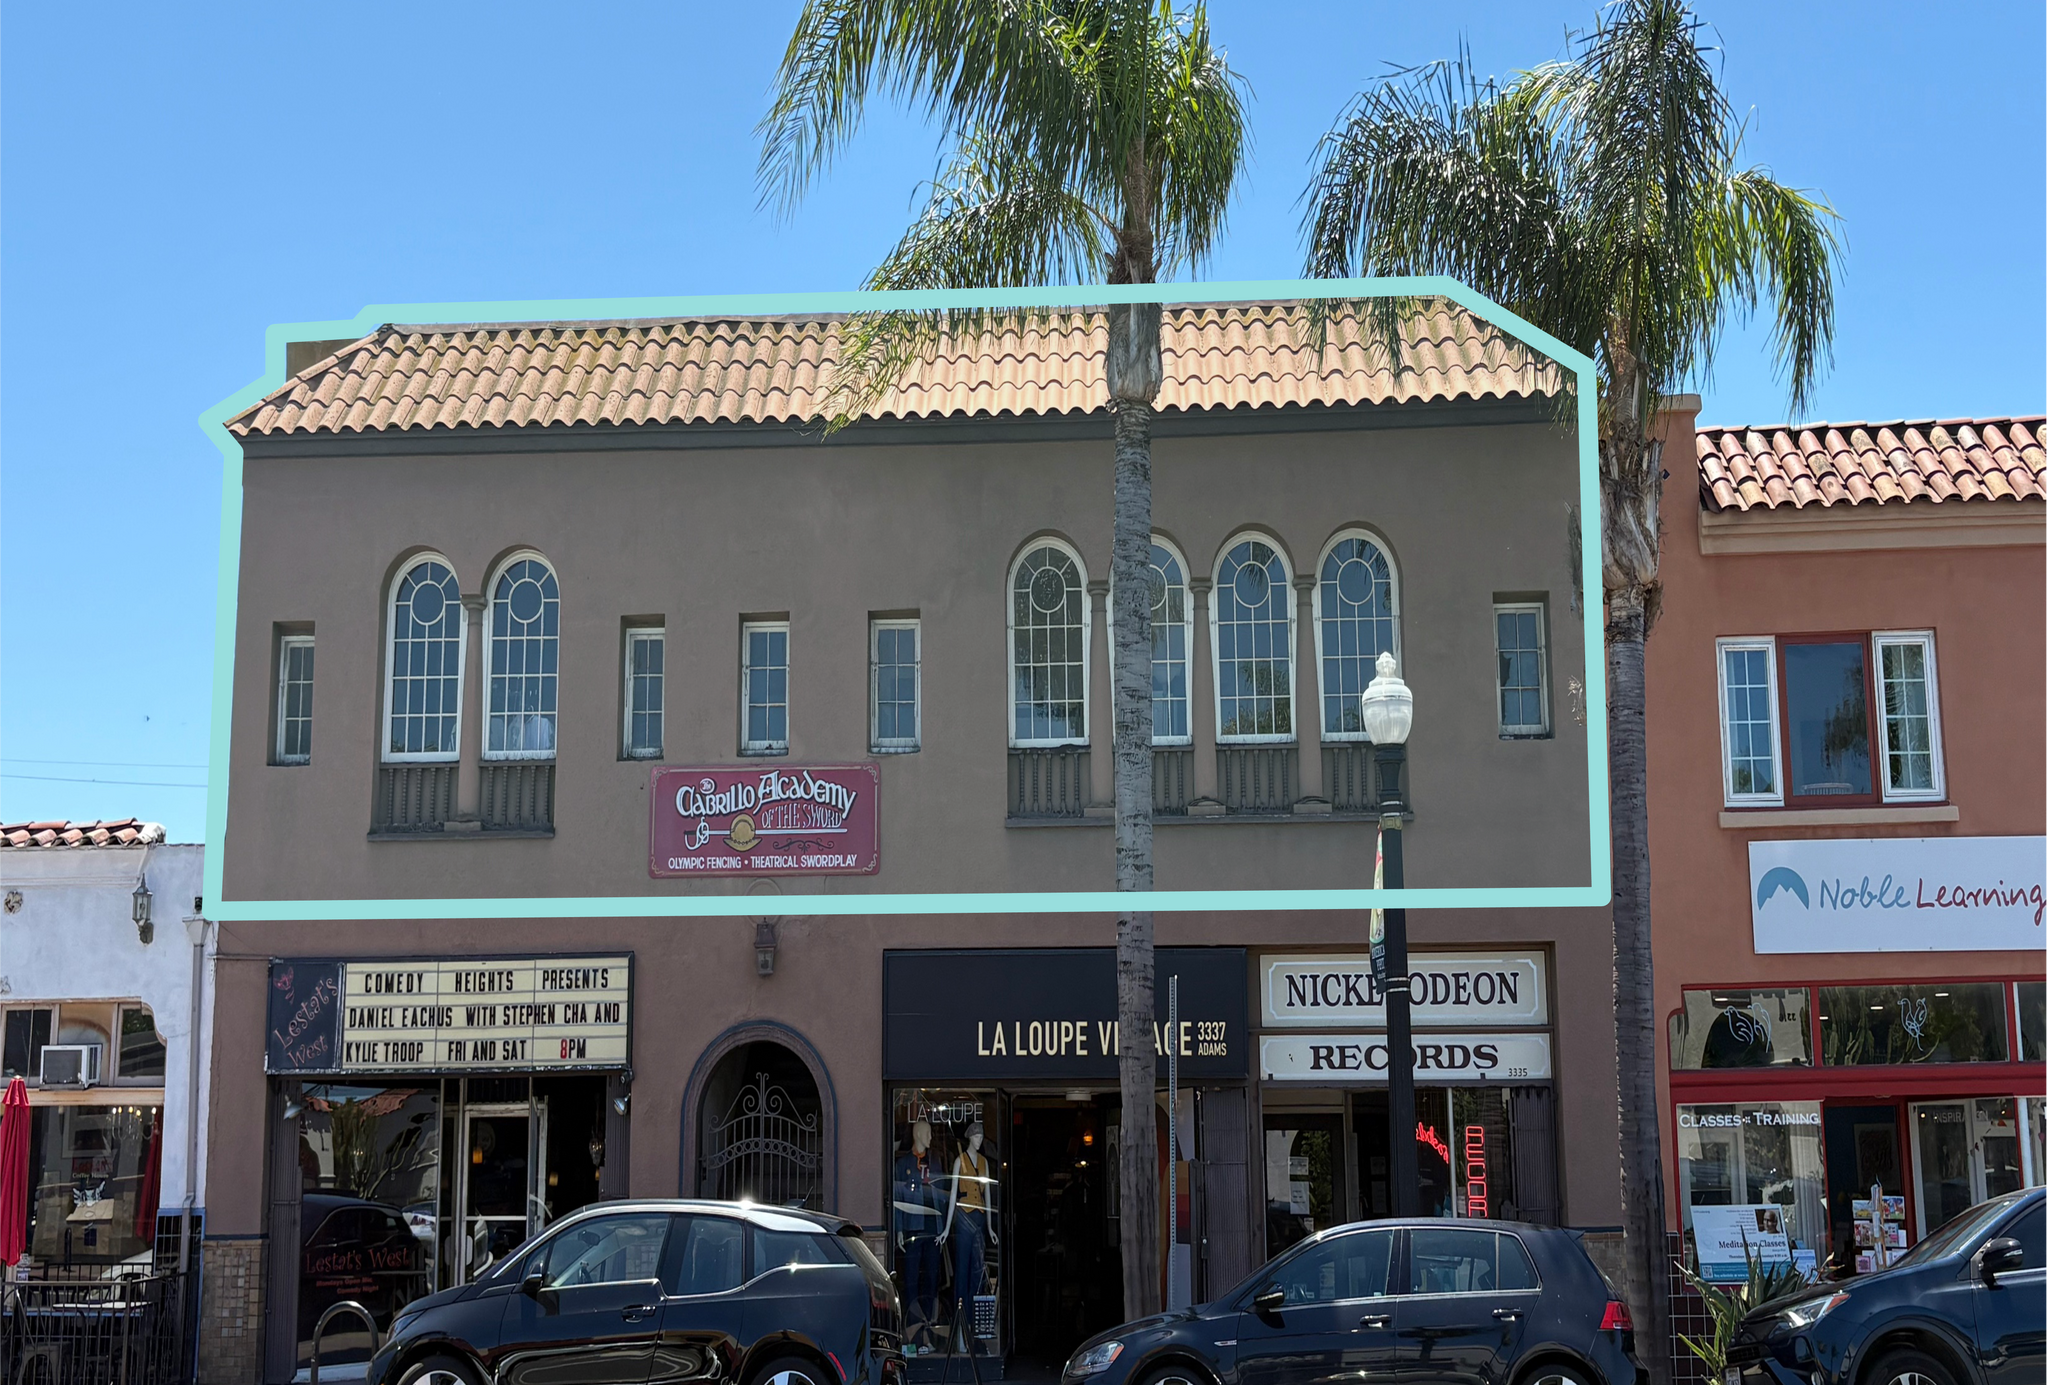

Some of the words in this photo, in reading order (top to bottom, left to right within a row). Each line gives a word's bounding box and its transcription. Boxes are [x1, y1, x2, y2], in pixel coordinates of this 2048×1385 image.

[761, 810, 774, 829] OF
[775, 804, 800, 828] THE
[802, 804, 842, 828] SWORD
[668, 856, 705, 870] OLYMPIC
[706, 856, 742, 869] FENCING
[750, 855, 798, 868] THEATRICAL
[800, 854, 858, 867] SWORDPLAY
[1820, 874, 1911, 910] Noble
[1916, 878, 2046, 926] Learning
[364, 972, 424, 994] COMEDY
[454, 970, 514, 992] HEIGHTS
[541, 968, 609, 990] PRESENTS
[1285, 971, 1520, 1007] NICKEODEON
[272, 976, 339, 1050] Lestat's
[348, 1006, 395, 1029] DANIEL
[402, 1005, 453, 1028] EACHUS
[465, 1005, 496, 1027] WITH
[502, 1003, 556, 1026] STEPHEN
[563, 1002, 587, 1024] CHA
[594, 1001, 621, 1024] AND
[977, 1021, 1007, 1056] LA
[1015, 1021, 1088, 1056] LOUPE
[1197, 1021, 1226, 1041] 3337
[286, 1033, 329, 1069] West
[345, 1041, 378, 1063] KYLIE
[384, 1041, 424, 1063] TROOP
[447, 1040, 467, 1061] FRI
[472, 1040, 497, 1061] AND
[502, 1039, 527, 1061] SAT
[559, 1038, 587, 1060] 8PM
[1197, 1042, 1227, 1056] ADAMS
[1309, 1043, 1499, 1071] RECRDS
[1507, 1067, 1528, 1077] 3335
[907, 1103, 929, 1123] LA
[931, 1103, 984, 1123] LOUPE
[1679, 1114, 1742, 1127] CLASSES
[1753, 1112, 1820, 1126] TRAINING
[1465, 1125, 1488, 1218] RECOR
[1718, 1240, 1758, 1249] Meditaon
[1760, 1239, 1787, 1248] Classes
[306, 1249, 362, 1273] Lestat's
[368, 1247, 411, 1268] West
